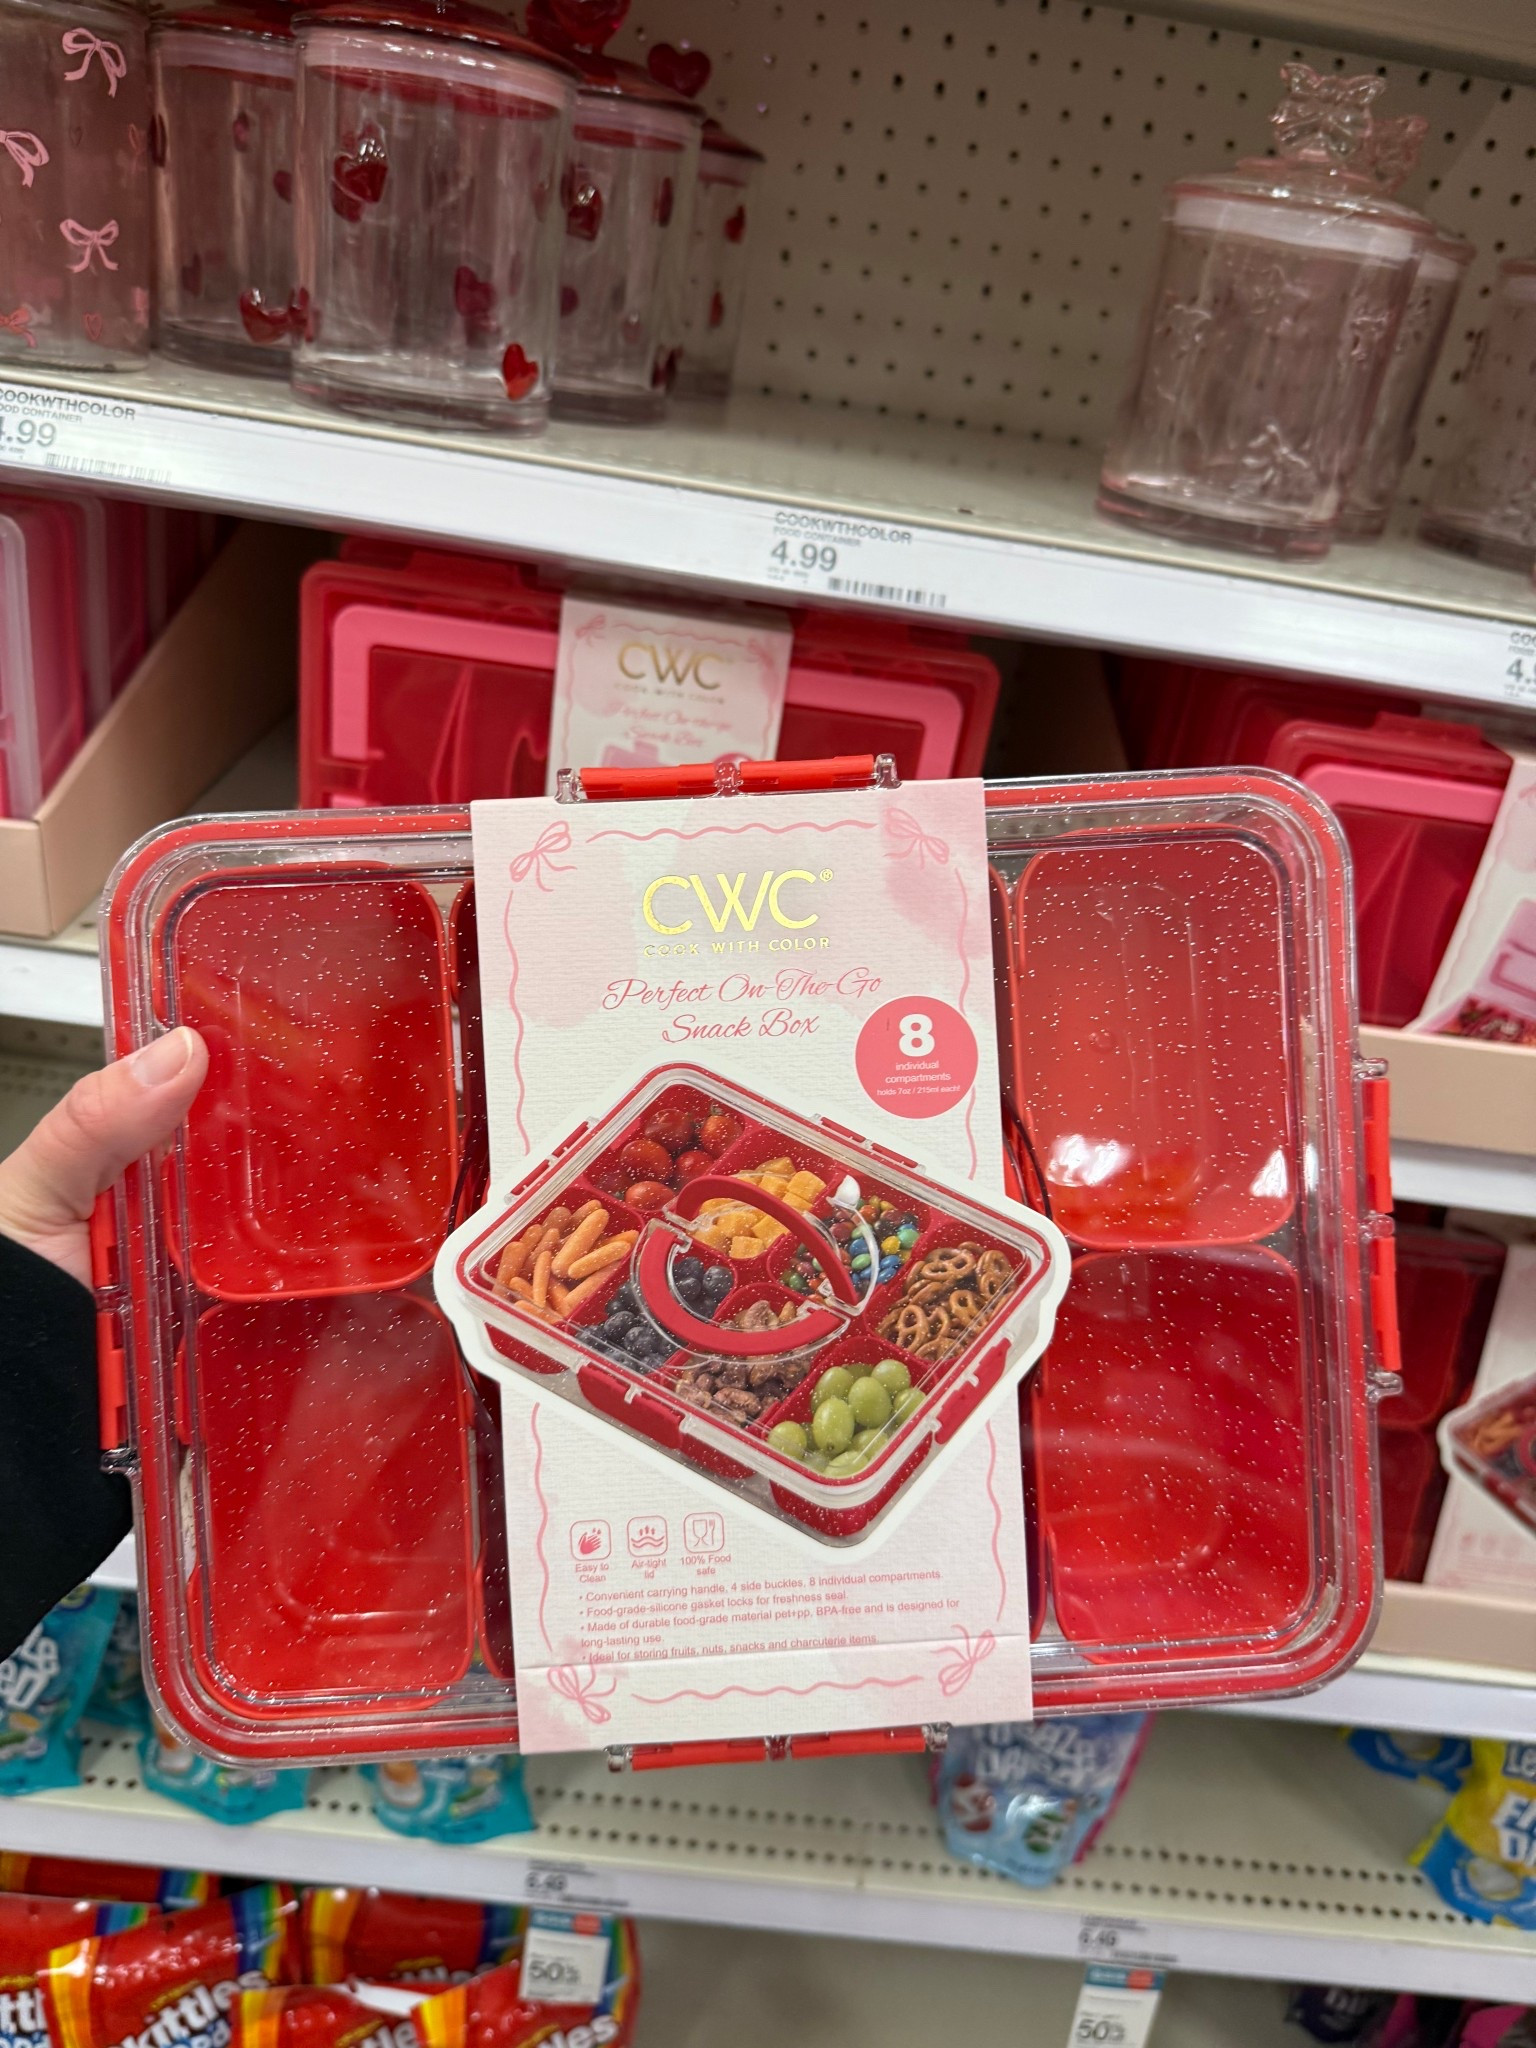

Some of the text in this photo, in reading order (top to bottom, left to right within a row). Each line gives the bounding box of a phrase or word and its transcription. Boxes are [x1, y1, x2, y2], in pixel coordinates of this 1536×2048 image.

[22, 407, 82, 422] CONTAINER
[775, 511, 912, 544] COOKWTHCOLOR
[771, 540, 837, 573] 4.99
[643, 937, 830, 958] COOK WITH COLOR
[603, 967, 882, 1011] Perfect On-The-Go
[662, 1008, 819, 1043] Snack Box
[899, 1014, 935, 1057] 8
[895, 1061, 939, 1070] individual
[885, 1073, 951, 1084] compartments
[877, 1088, 896, 1096] holds
[631, 1558, 667, 1569] Air-tight
[680, 1554, 731, 1566] 100% Food
[575, 1563, 597, 1573] Easy
[645, 1570, 655, 1579] lid
[696, 1566, 716, 1575] safe
[579, 1575, 606, 1583] Clean
[586, 1589, 644, 1601] Convenient
[647, 1587, 688, 1599] carrying
[731, 1582, 737, 1591] 4
[740, 1581, 762, 1591] side
[809, 1577, 816, 1586] 8
[819, 1574, 866, 1586] individual
[587, 1590, 848, 1617] Food-grade-silicone gasket locks for freshness seal.
[588, 1622, 616, 1632] Made
[620, 1621, 629, 1630] of
[632, 1618, 670, 1629] durable
[673, 1614, 728, 1627] food-grade
[732, 1612, 772, 1623] material
[816, 1605, 861, 1616] BPA-free
[864, 1604, 883, 1614] and
[886, 1602, 894, 1612] is
[897, 1600, 943, 1613] designed
[946, 1599, 960, 1608] for
[581, 1634, 664, 1648] long-lasting use.
[589, 1652, 614, 1663] Ideal
[617, 1650, 630, 1661] for
[634, 1648, 668, 1661] storing
[730, 1641, 765, 1651] snacks
[768, 1639, 788, 1649] and
[790, 1635, 847, 1648] charcuterie
